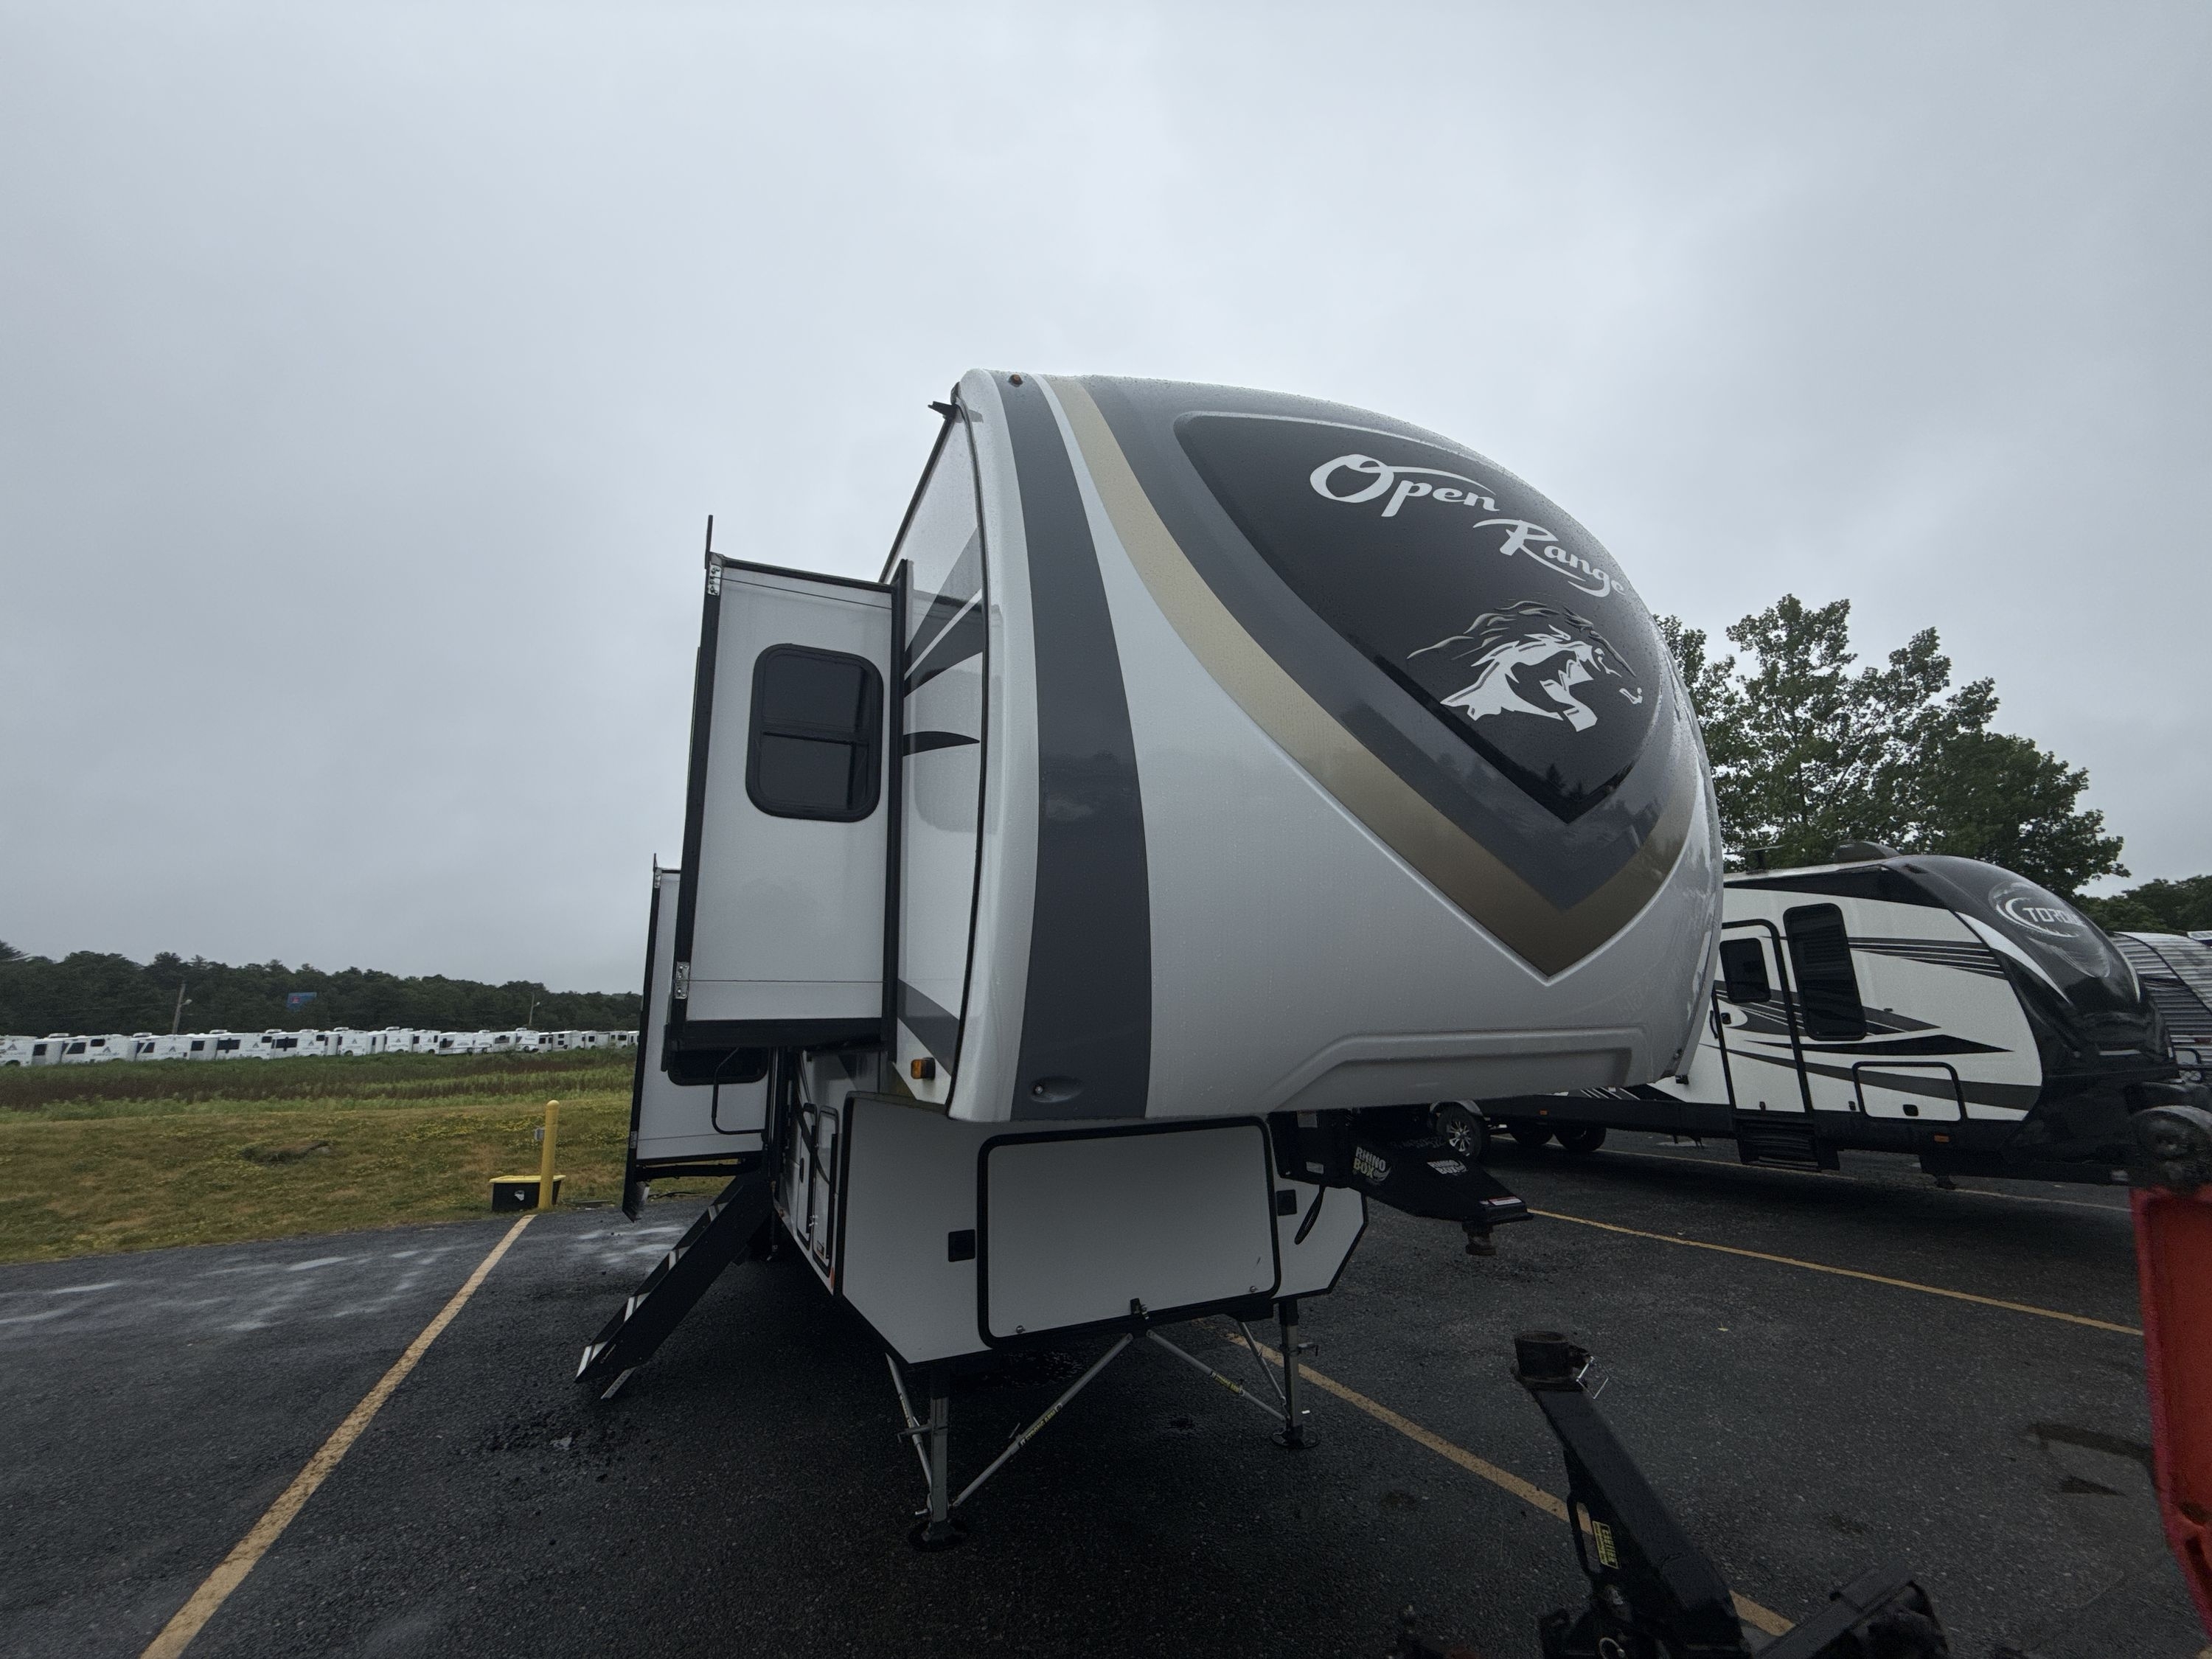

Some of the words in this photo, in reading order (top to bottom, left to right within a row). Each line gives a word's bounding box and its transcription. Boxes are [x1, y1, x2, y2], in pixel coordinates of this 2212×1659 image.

[1310, 453, 1500, 518] Open
[1472, 518, 1626, 598] Range
[2022, 907, 2087, 928] TORQ
[1353, 1158, 1374, 1178] BOX
[1355, 1146, 1386, 1171] RHINO
